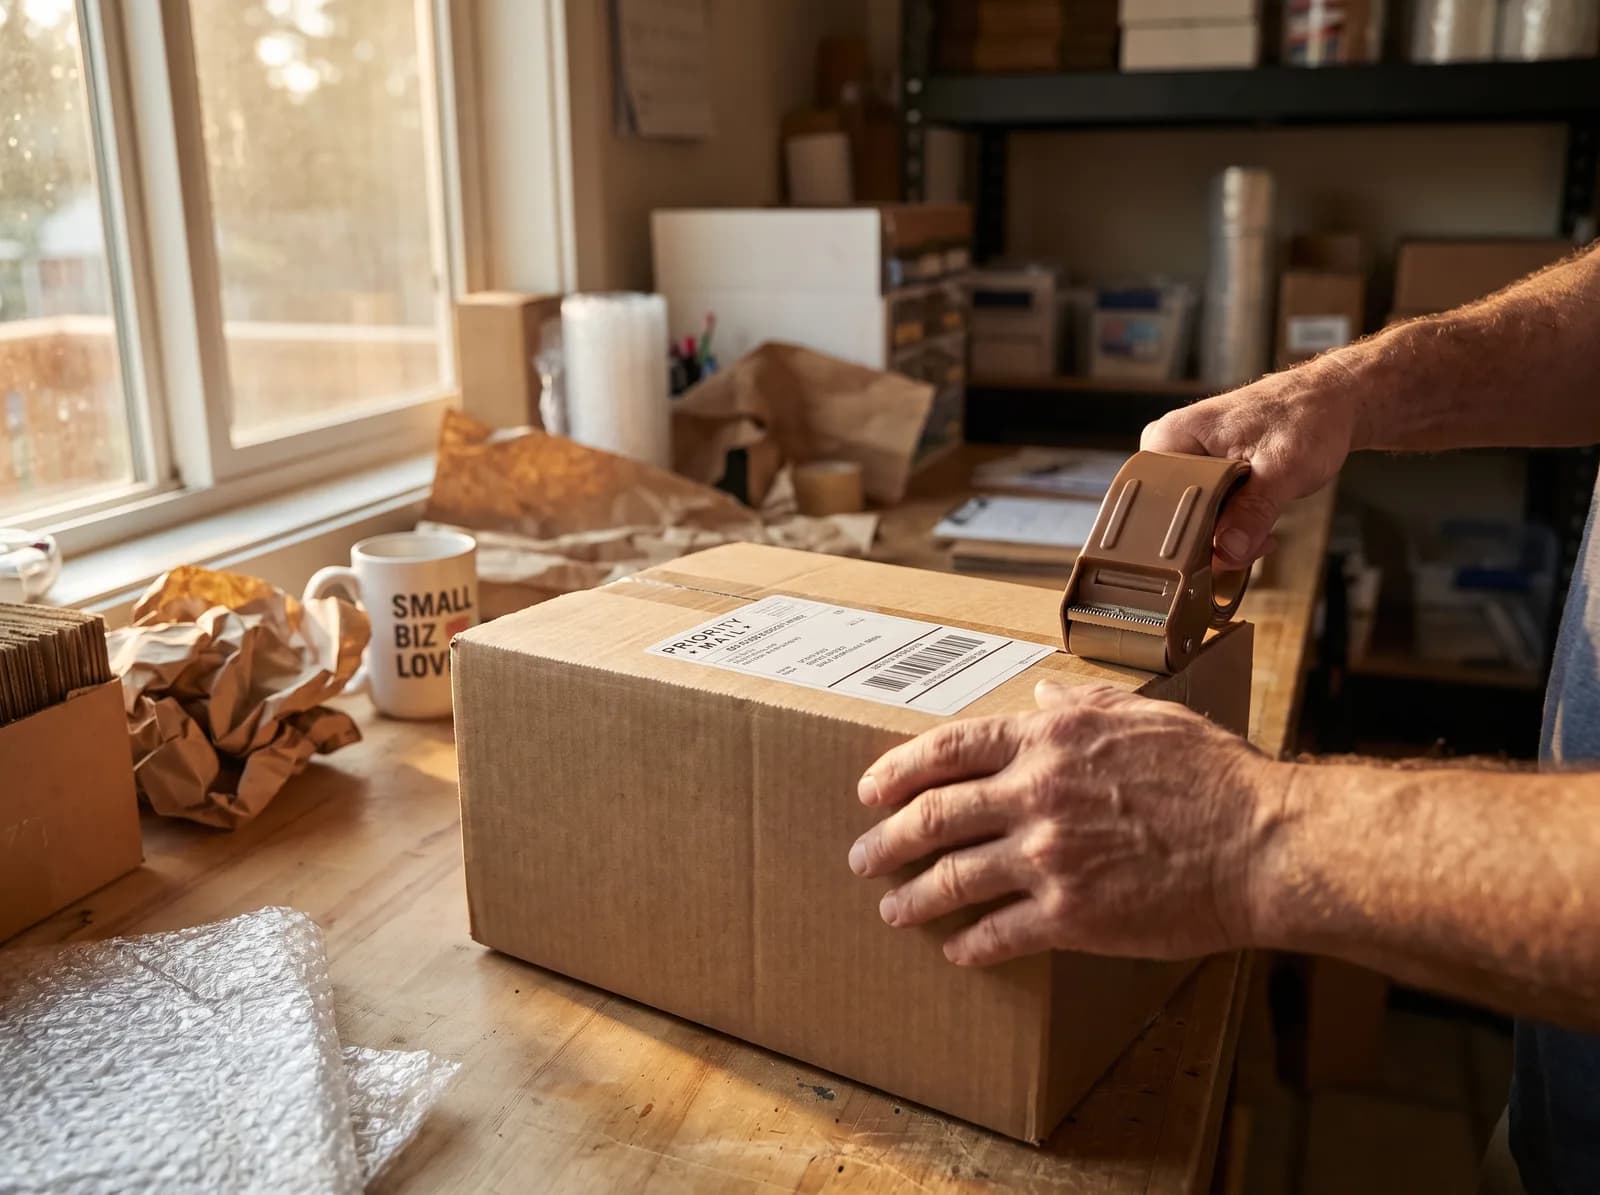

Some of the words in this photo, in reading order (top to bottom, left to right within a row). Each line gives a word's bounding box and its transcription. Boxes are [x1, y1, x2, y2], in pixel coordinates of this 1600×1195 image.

[392, 586, 472, 618] SMALL
[395, 623, 436, 648] BIZ
[661, 617, 742, 654] PRIORITY
[697, 630, 746, 650] MAIL
